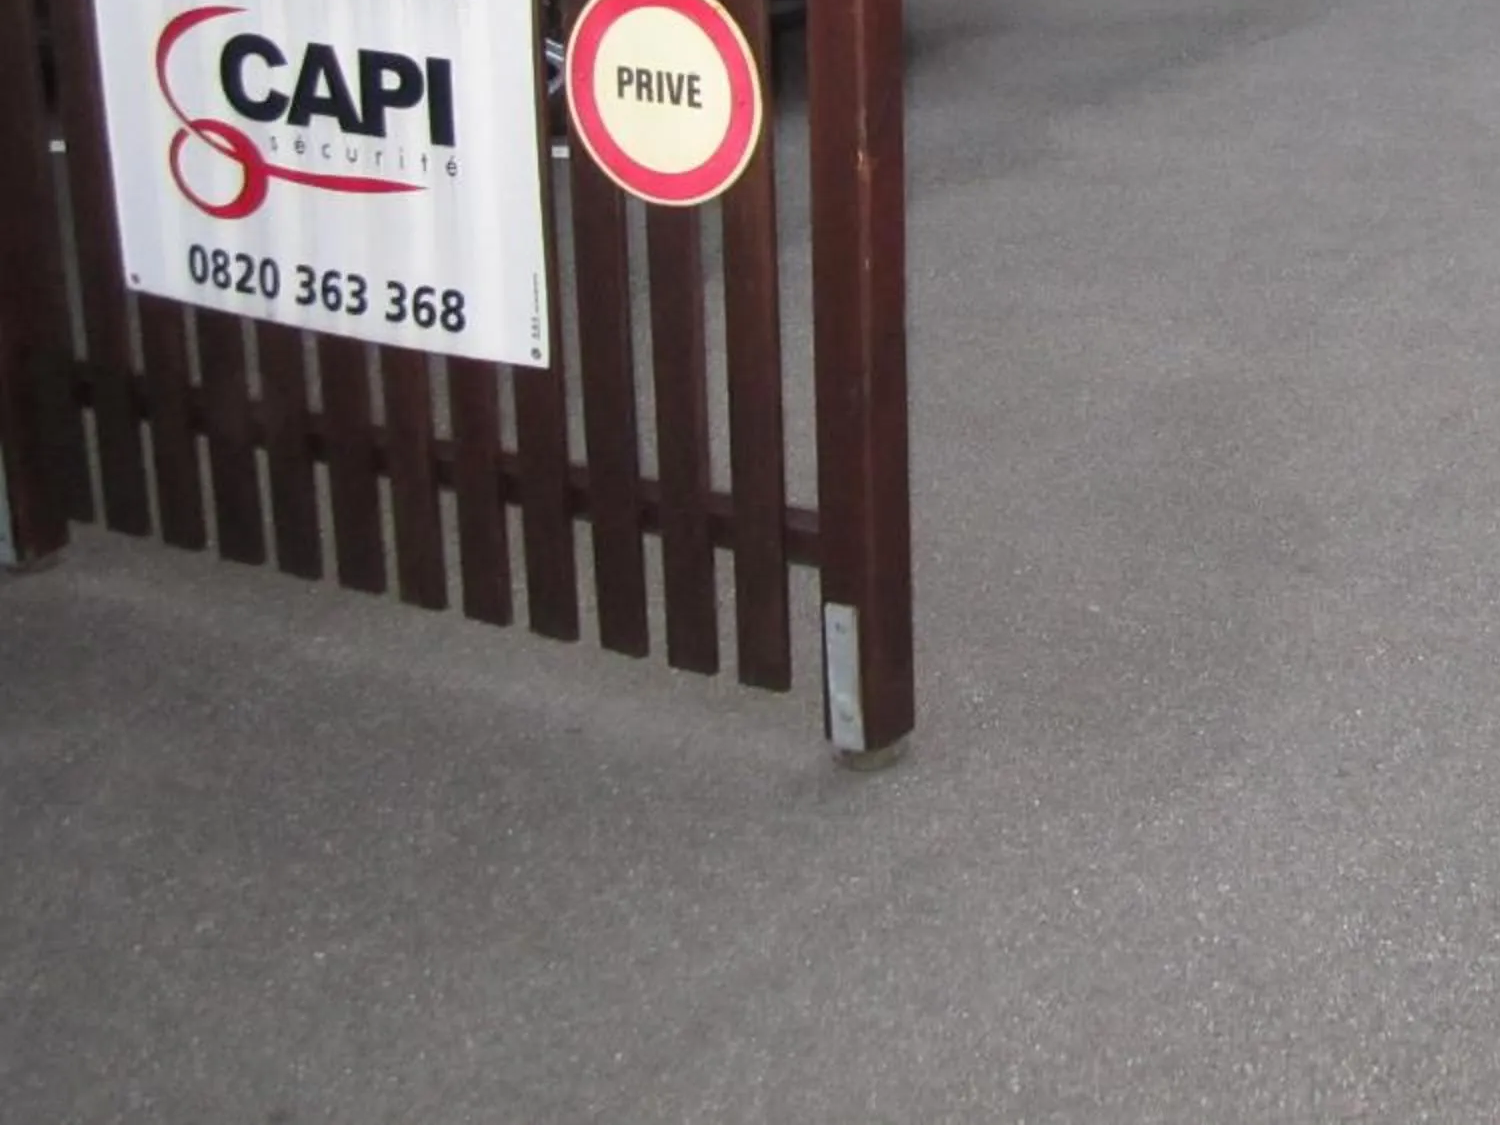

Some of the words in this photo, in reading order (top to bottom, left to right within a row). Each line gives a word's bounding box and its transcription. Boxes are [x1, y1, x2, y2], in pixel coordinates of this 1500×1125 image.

[219, 32, 456, 148] CAPI
[616, 65, 703, 110] PRIVE
[269, 134, 459, 177] sécurité
[188, 243, 281, 300] 0820
[294, 264, 369, 316] 363
[385, 280, 467, 333] 368
